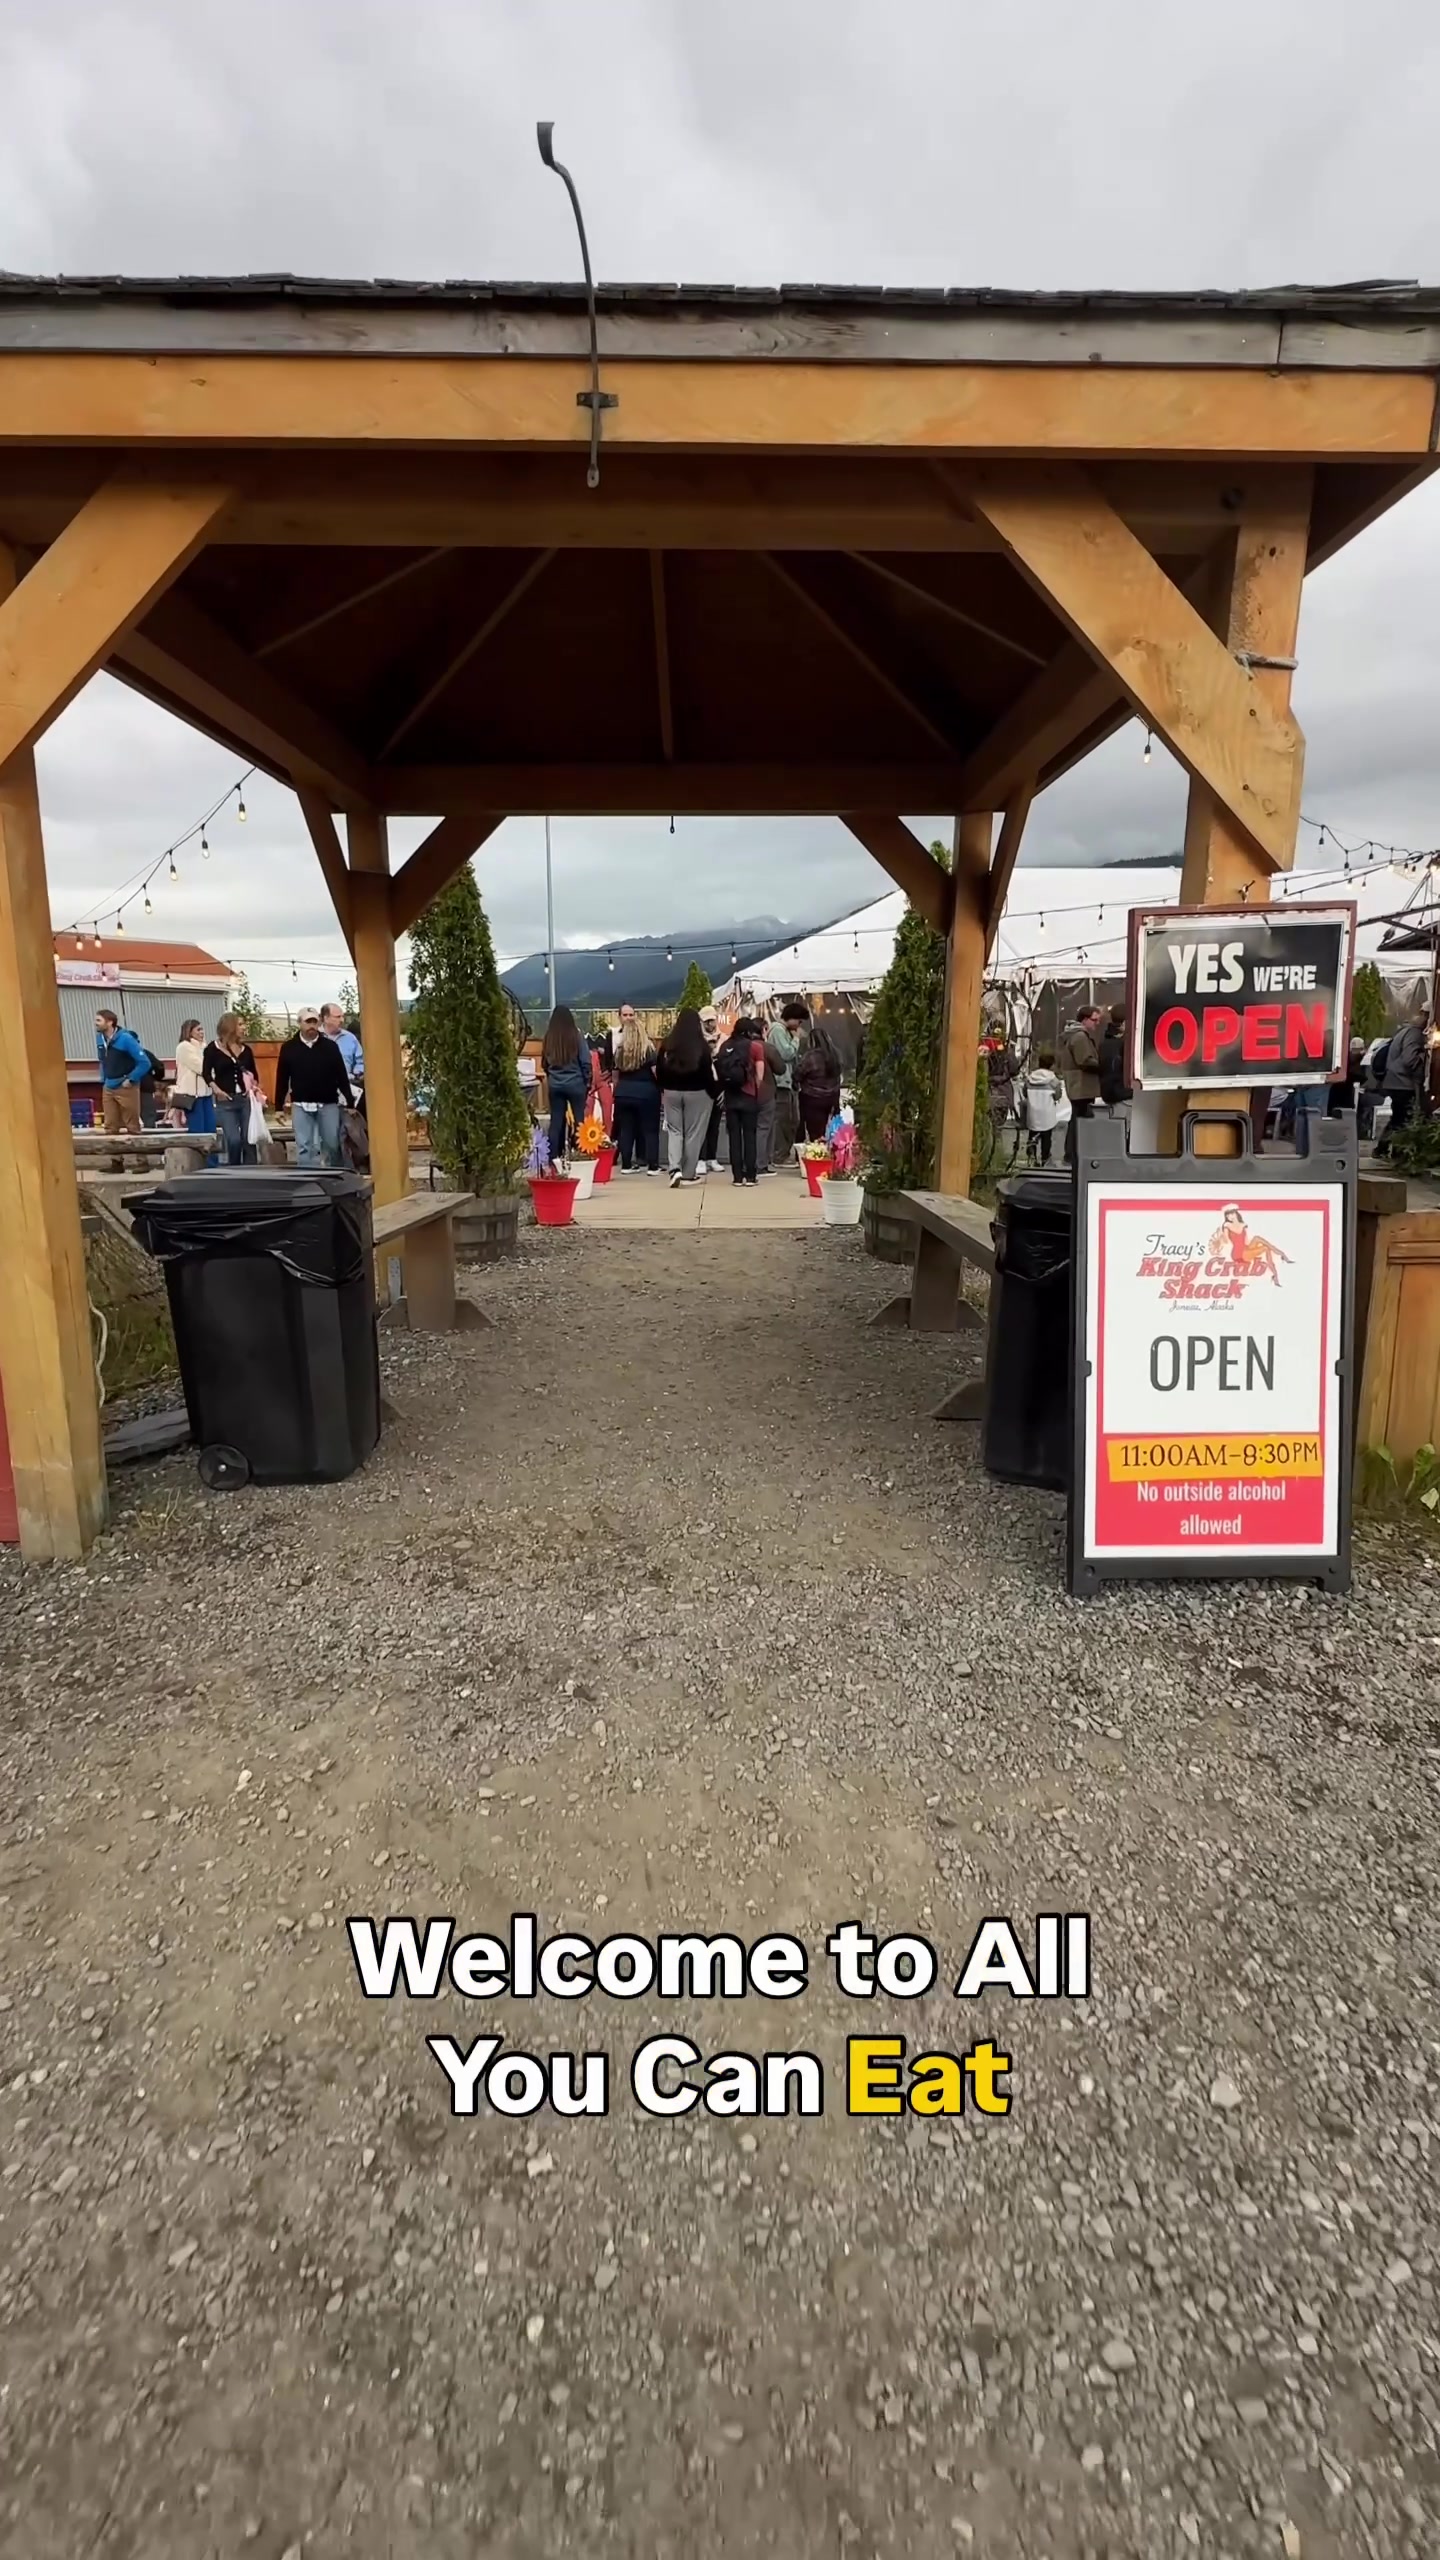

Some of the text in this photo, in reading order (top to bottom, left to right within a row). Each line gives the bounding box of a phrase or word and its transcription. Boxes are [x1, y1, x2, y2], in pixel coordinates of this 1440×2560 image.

[1168, 942, 1317, 994] YES WE'RE
[1154, 1002, 1326, 1064] OPEN
[1144, 1234, 1205, 1261] Tracy's
[1136, 1257, 1267, 1282] King Crab
[1159, 1279, 1248, 1299] Shack
[1150, 1335, 1274, 1392] OPEN
[1137, 1480, 1286, 1502] No outside alcohol
[1180, 1514, 1242, 1535] allowed
